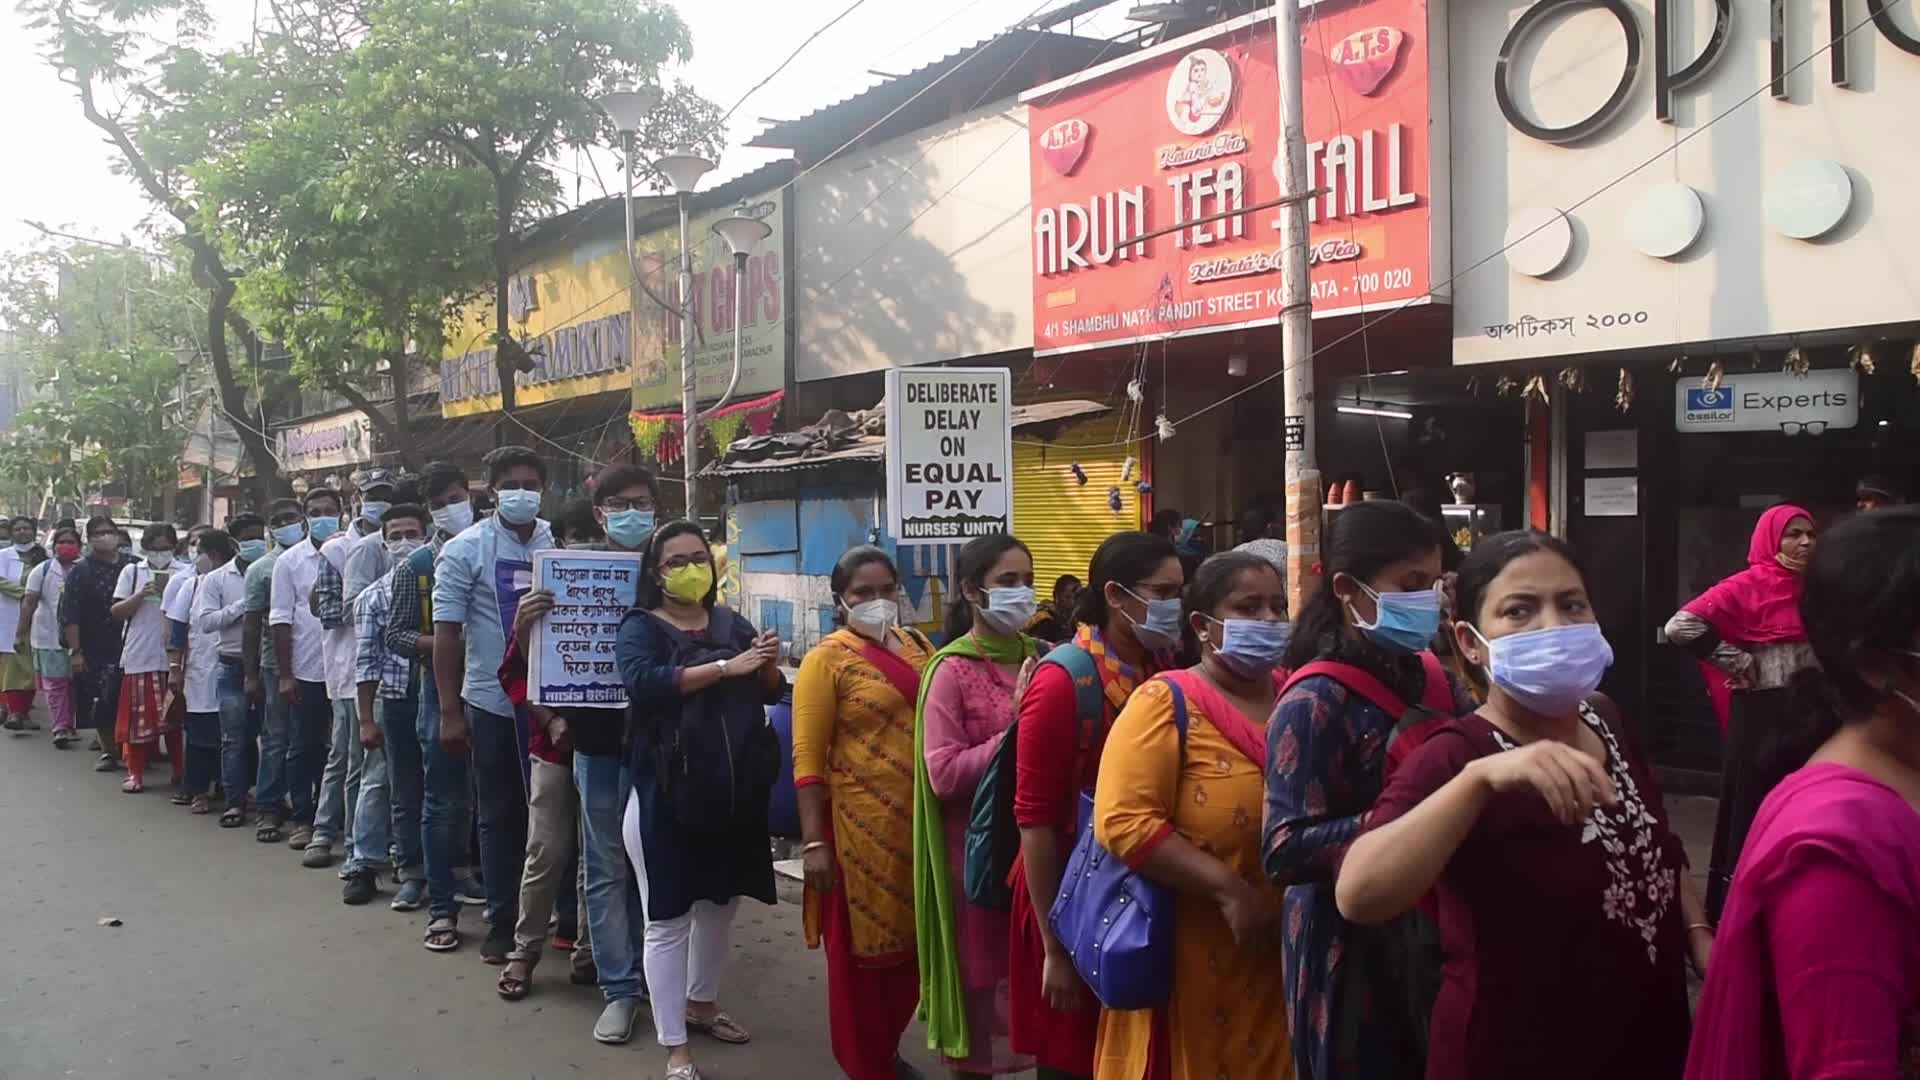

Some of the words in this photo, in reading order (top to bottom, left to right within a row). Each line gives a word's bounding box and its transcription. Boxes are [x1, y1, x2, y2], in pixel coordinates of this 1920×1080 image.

[1342, 28, 1390, 64] A.T.S
[1046, 120, 1080, 149] A.T.S
[1034, 184, 1145, 274] ARUN
[1166, 161, 1245, 247] TEA
[1319, 240, 1361, 263] Tea
[1062, 316, 1119, 336] SHAMBHU
[1122, 309, 1154, 330] NATH
[1158, 302, 1203, 325] PANDIT
[1207, 294, 1263, 315] STREET
[1352, 273, 1381, 295] 700
[1383, 269, 1412, 291] 020
[1586, 310, 1649, 332] ২০০০
[906, 383, 998, 403] DELIBERATE
[1743, 391, 1848, 412] Experts
[924, 410, 980, 430] DELAY
[1686, 411, 1732, 421] essilor
[940, 436, 965, 456] ON
[905, 463, 1002, 484] EQUAL
[925, 490, 983, 510] PAY
[904, 522, 960, 537] NURSES'
[964, 522, 1004, 536] UNITY
[556, 641, 590, 653] বেতন
[562, 654, 592, 677] দিতে
